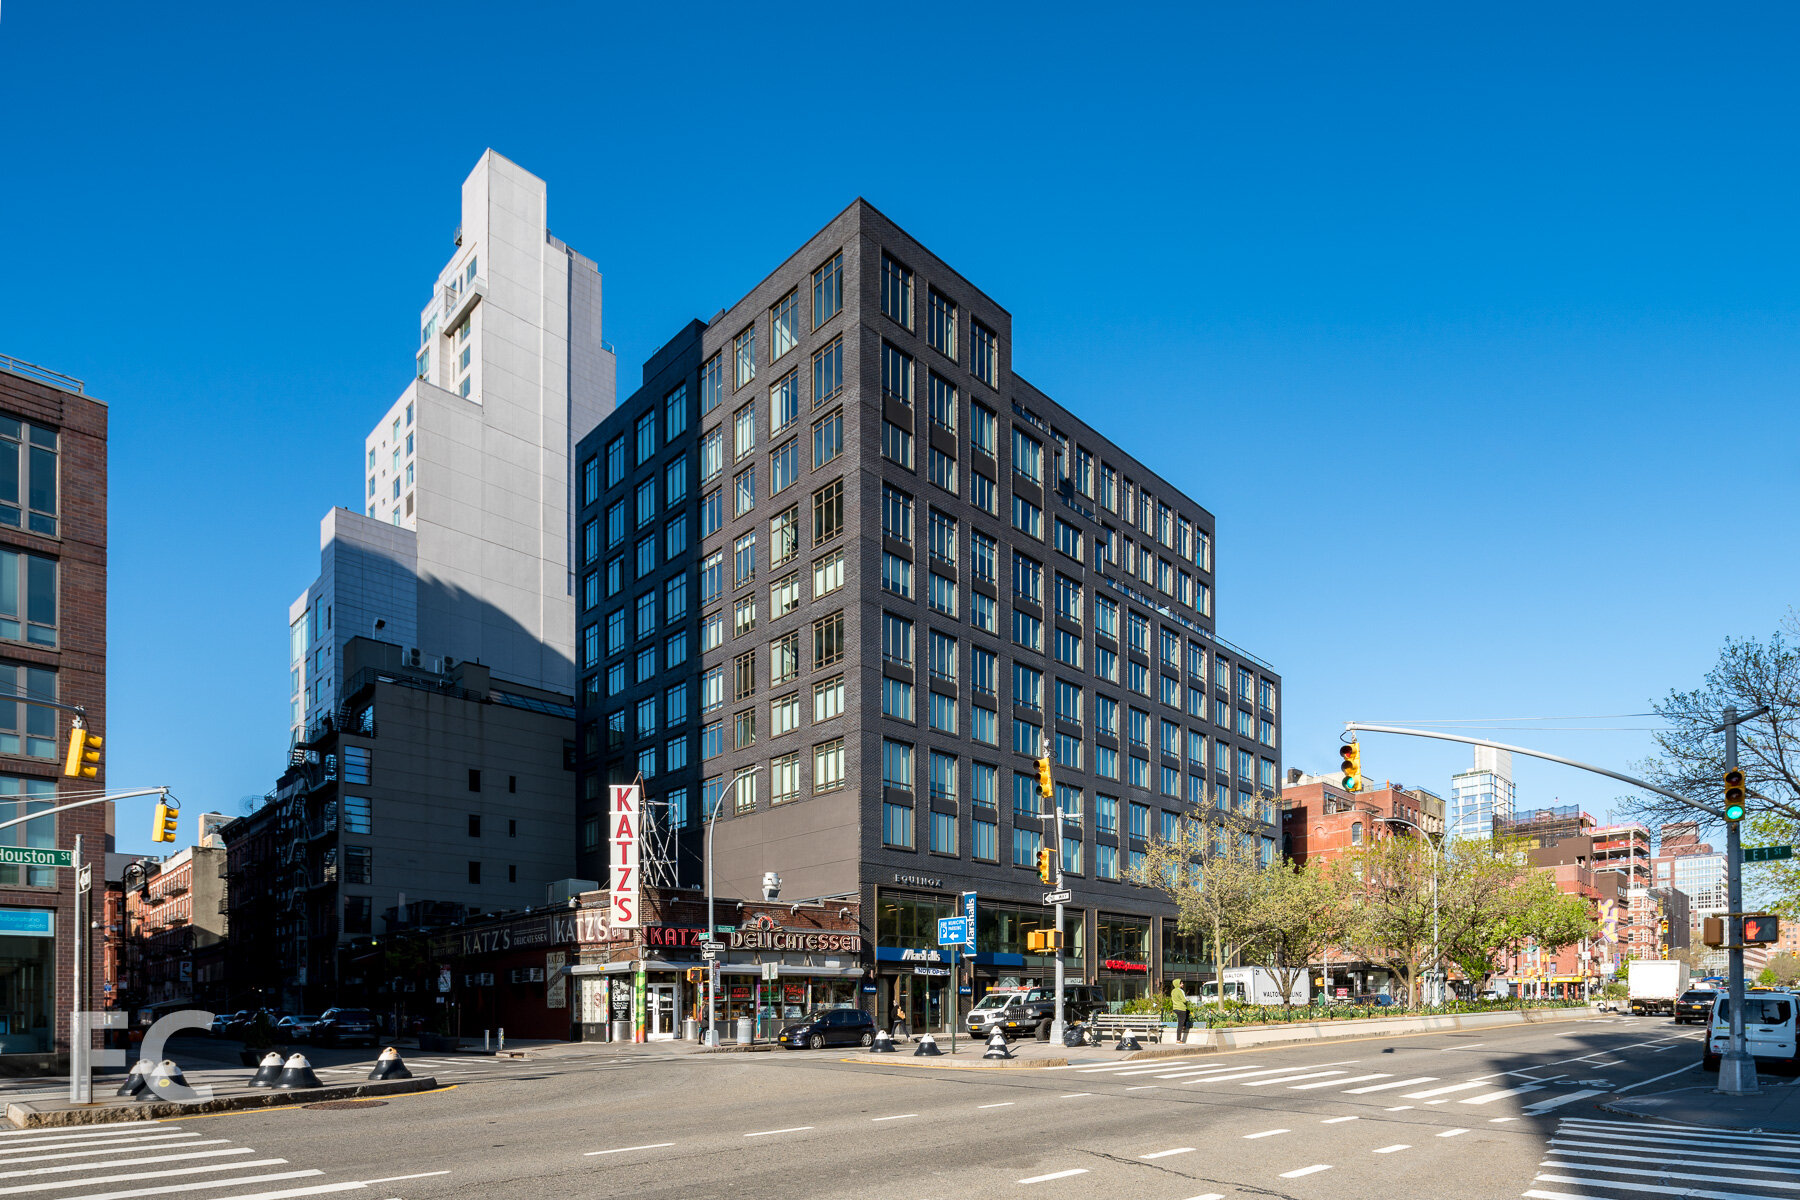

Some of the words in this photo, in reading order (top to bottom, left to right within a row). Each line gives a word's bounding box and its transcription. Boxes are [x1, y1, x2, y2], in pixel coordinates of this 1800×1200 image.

[61, 852, 71, 861] St
[614, 787, 634, 922] KATZ'S
[1752, 850, 1759, 861] E
[894, 873, 944, 888] EQUINOX
[555, 916, 608, 943] KATZ'S
[965, 897, 976, 951] Marshalls
[463, 928, 512, 955] KATZ'S
[650, 928, 706, 947] KATZ'
[902, 948, 941, 962] Marshalls
